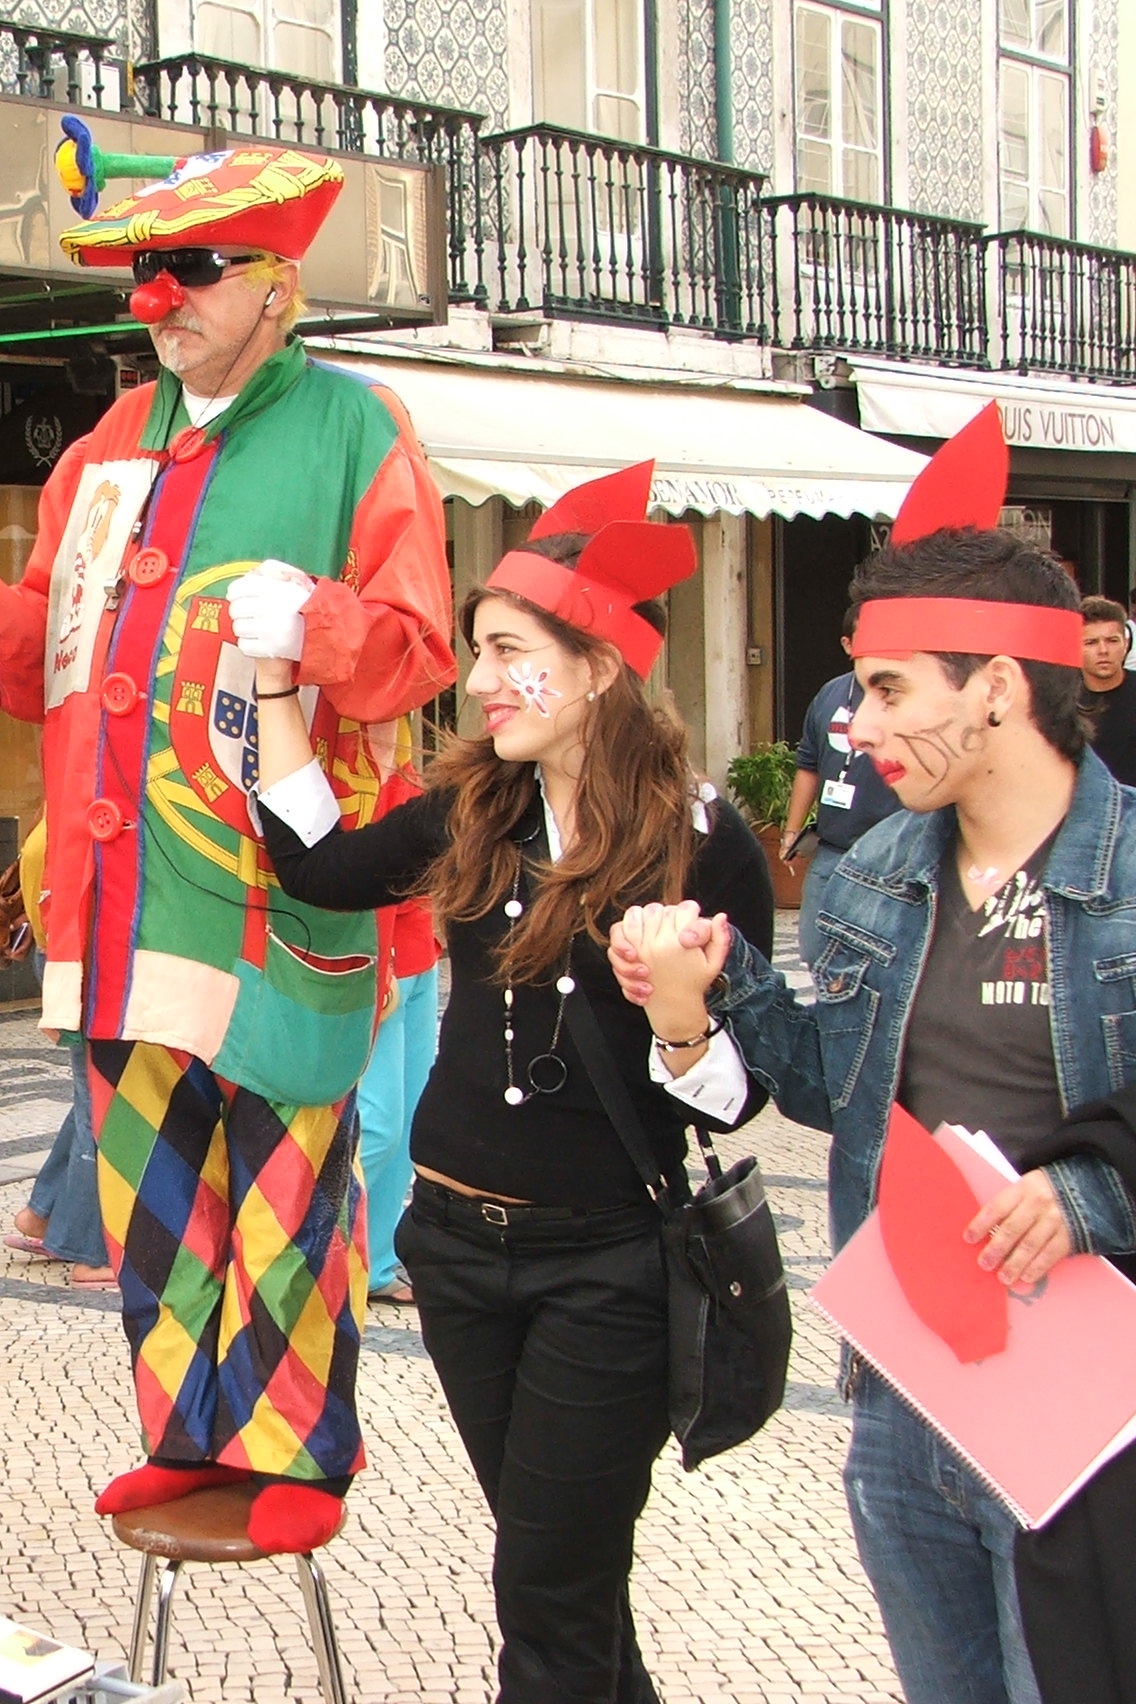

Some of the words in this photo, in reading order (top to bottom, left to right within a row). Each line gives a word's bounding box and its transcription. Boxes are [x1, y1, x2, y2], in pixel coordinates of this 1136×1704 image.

[996, 404, 1033, 443] UIS
[1040, 411, 1116, 447] VUITTON
[981, 980, 1025, 1005] MOTO
